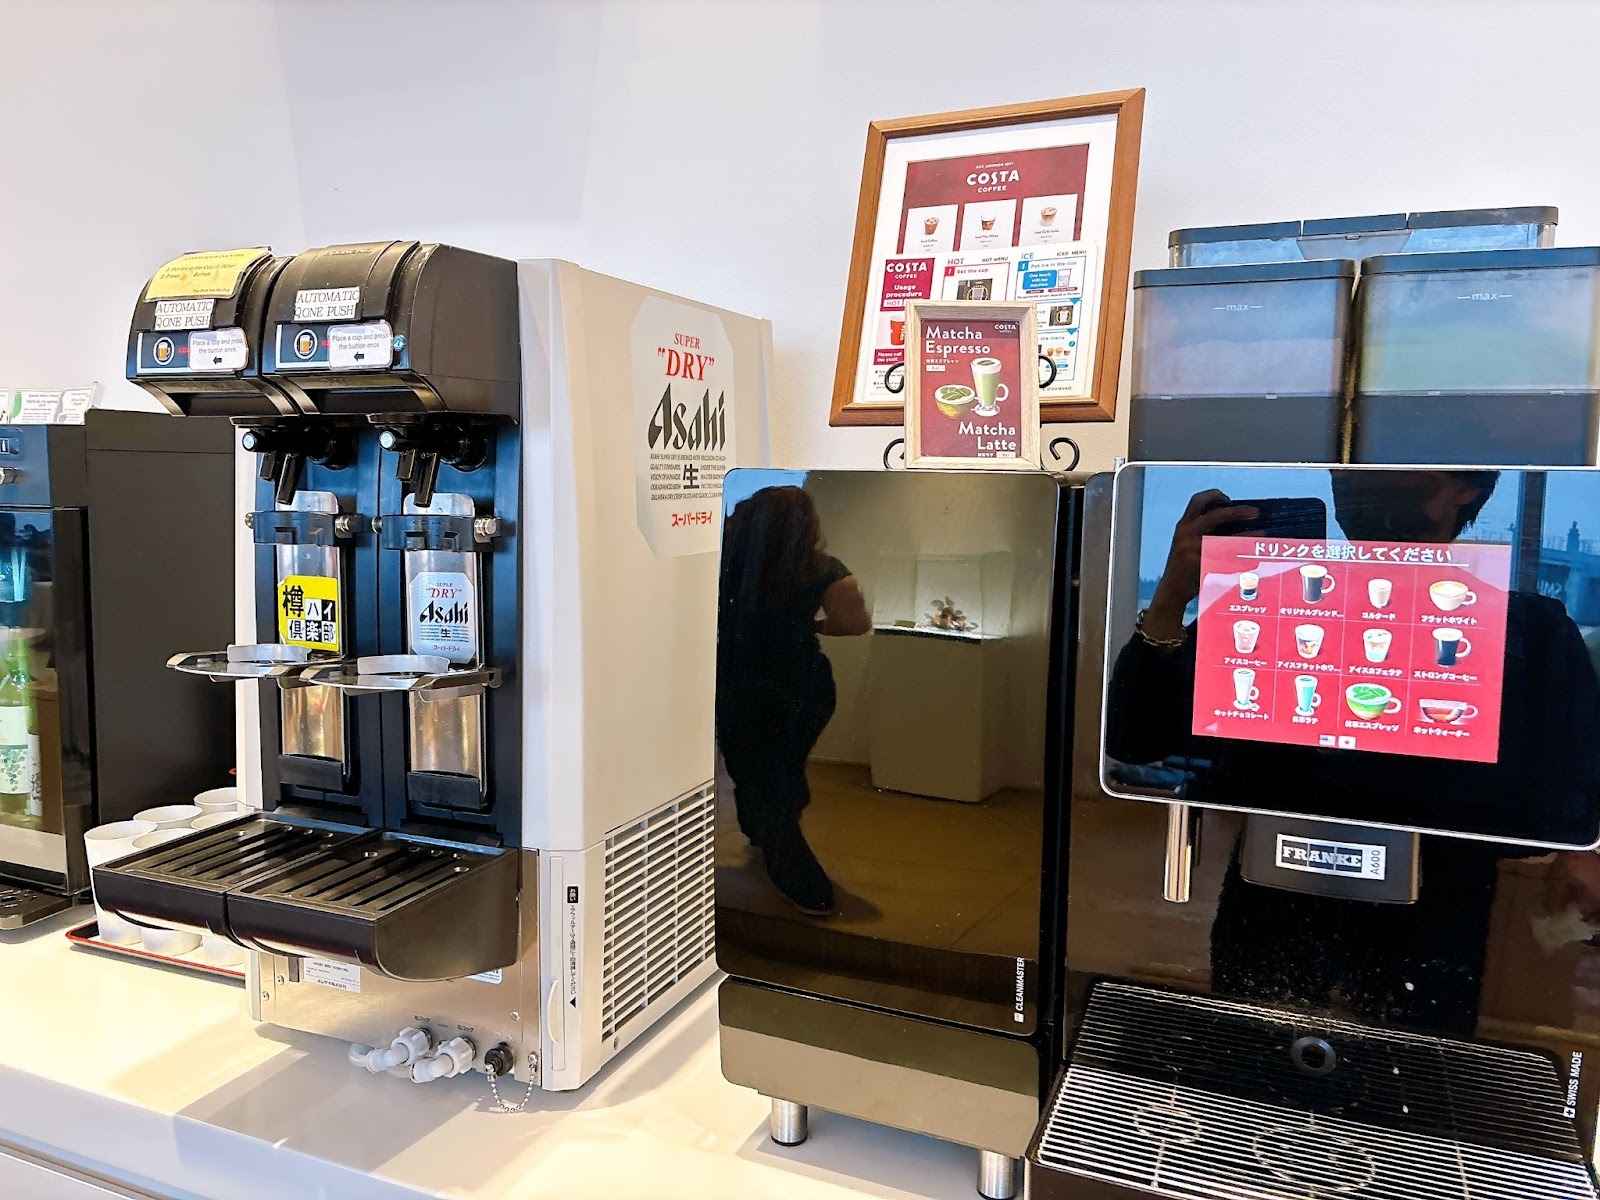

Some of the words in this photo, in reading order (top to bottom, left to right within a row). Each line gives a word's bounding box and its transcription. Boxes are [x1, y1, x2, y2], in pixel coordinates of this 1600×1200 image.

[966, 170, 1020, 186] COSTA
[886, 262, 927, 273] COSTA
[296, 290, 360, 303] AUTOMATIC
[1472, 291, 1497, 301] max
[156, 301, 212, 314] AUTOMATIC
[327, 305, 354, 317] PUSH
[1226, 302, 1249, 312] max
[184, 316, 209, 326] PUSH
[926, 326, 982, 340] Matcha
[674, 333, 700, 349] SUPER
[926, 340, 990, 358] Espresso
[648, 383, 725, 451] Asahi
[958, 421, 1016, 435] Matcha
[978, 436, 1016, 450] Latte
[683, 464, 699, 489] 生
[672, 511, 712, 526] スーパードライ
[1255, 542, 1452, 562] ドリンクを選択してください
[420, 600, 468, 624] Asahi
[1229, 604, 1266, 613] エスプレッソ
[1362, 612, 1395, 620] コルタード
[1421, 615, 1477, 625] フラットホワイト
[289, 621, 334, 642] 倶楽部
[441, 628, 451, 638] 生
[1224, 658, 1267, 666] アイスコーヒー
[1348, 666, 1402, 677] アイスカフェラテ
[1413, 671, 1477, 681] ストロングコーヒー
[1214, 709, 1269, 720] ホットチョコレート
[1413, 726, 1470, 737] ホットウォーター
[1282, 846, 1361, 867] FRANKE
[1370, 850, 1380, 875] A600
[1015, 957, 1025, 1011] CLEANMASTER
[1570, 1051, 1582, 1077] MADE
[1567, 1079, 1579, 1106] SWISS
